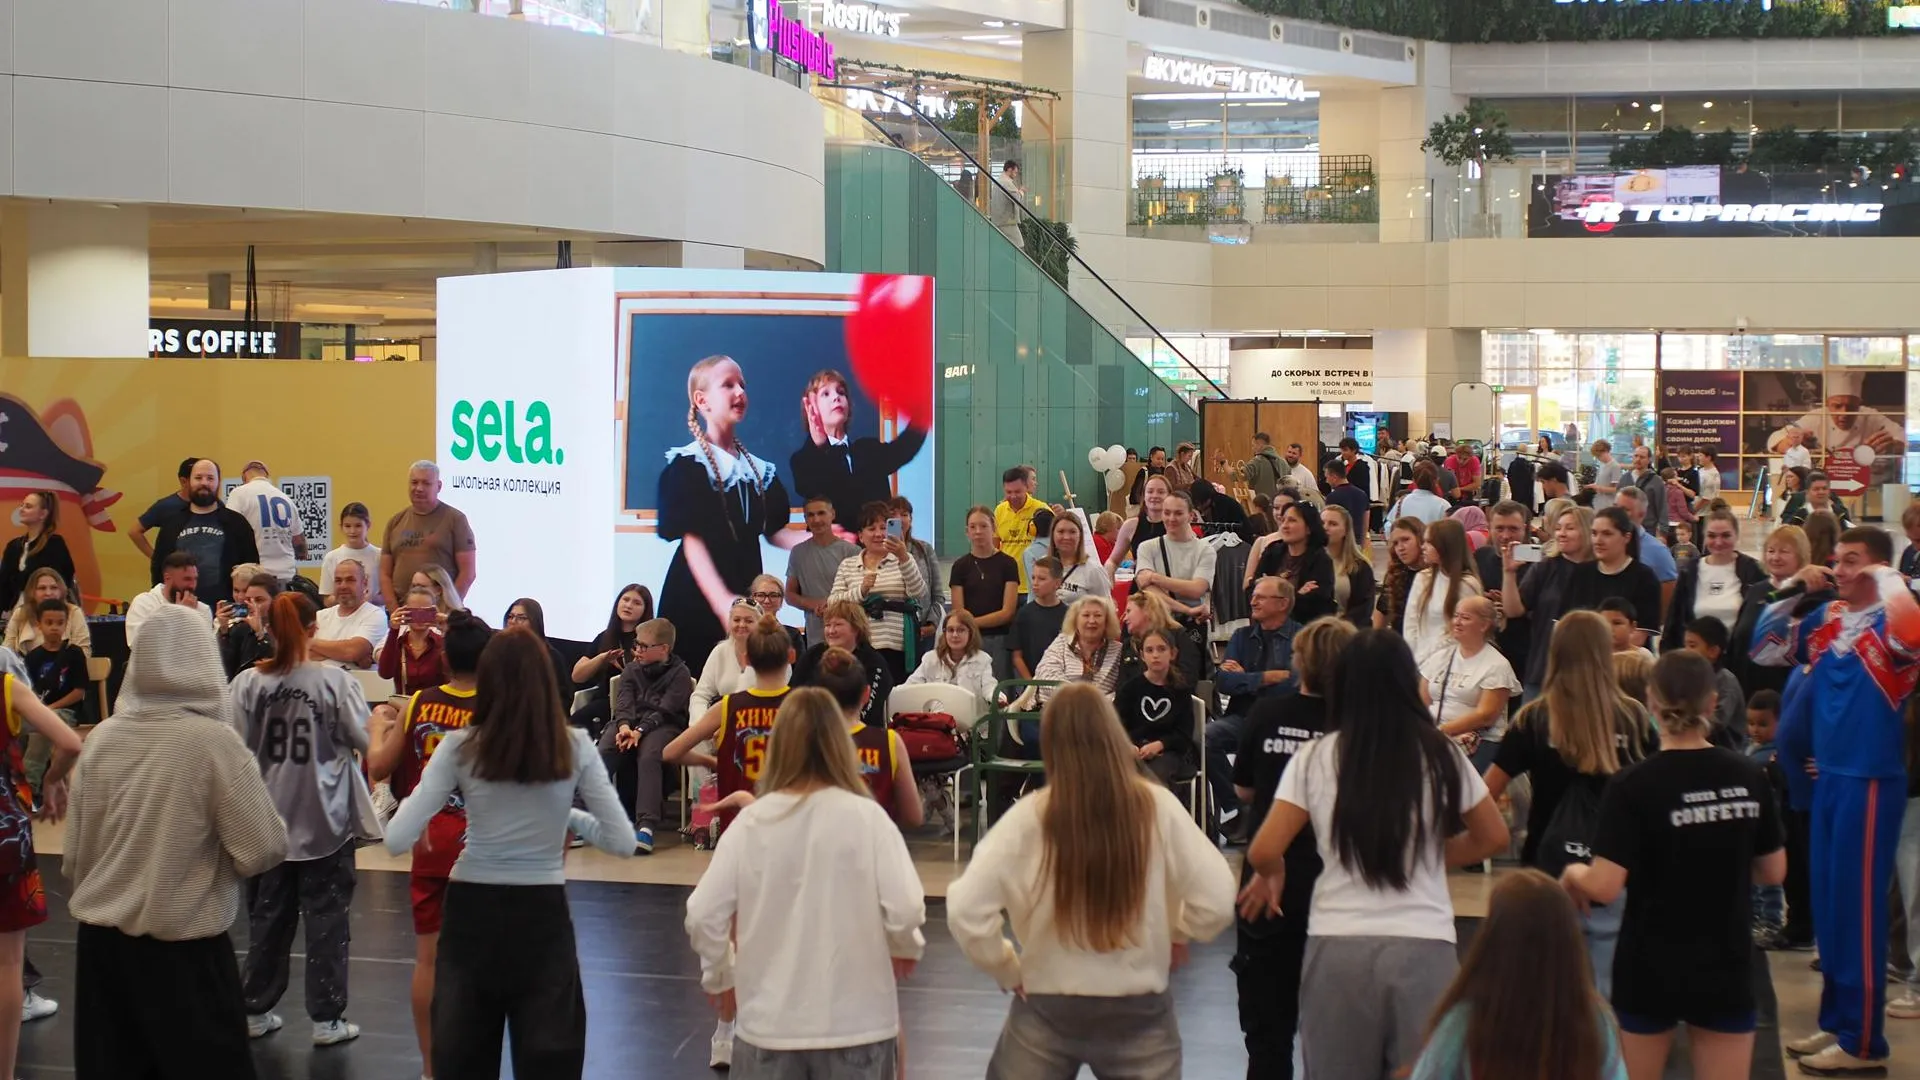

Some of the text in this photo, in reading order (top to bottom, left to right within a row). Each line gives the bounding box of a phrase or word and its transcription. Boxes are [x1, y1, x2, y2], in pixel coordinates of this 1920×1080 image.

[823, 0, 901, 37] ROSTIC'S
[1145, 55, 1215, 88] ВКУСНО
[1251, 71, 1305, 101] ТОЧКА
[1630, 203, 1884, 222] TOPRACING
[186, 329, 276, 354] COFFEE
[1271, 370, 1282, 378] ДО
[1678, 387, 1716, 396] Уралсиб
[451, 400, 564, 465] sela.
[1666, 417, 1702, 425] Каждый
[452, 475, 561, 496] школьная коллекция
[257, 494, 292, 528] 10
[177, 526, 200, 539] URF
[735, 707, 779, 728] ХИМ
[267, 717, 311, 765] 86
[1671, 802, 1761, 827] CONFETTI
